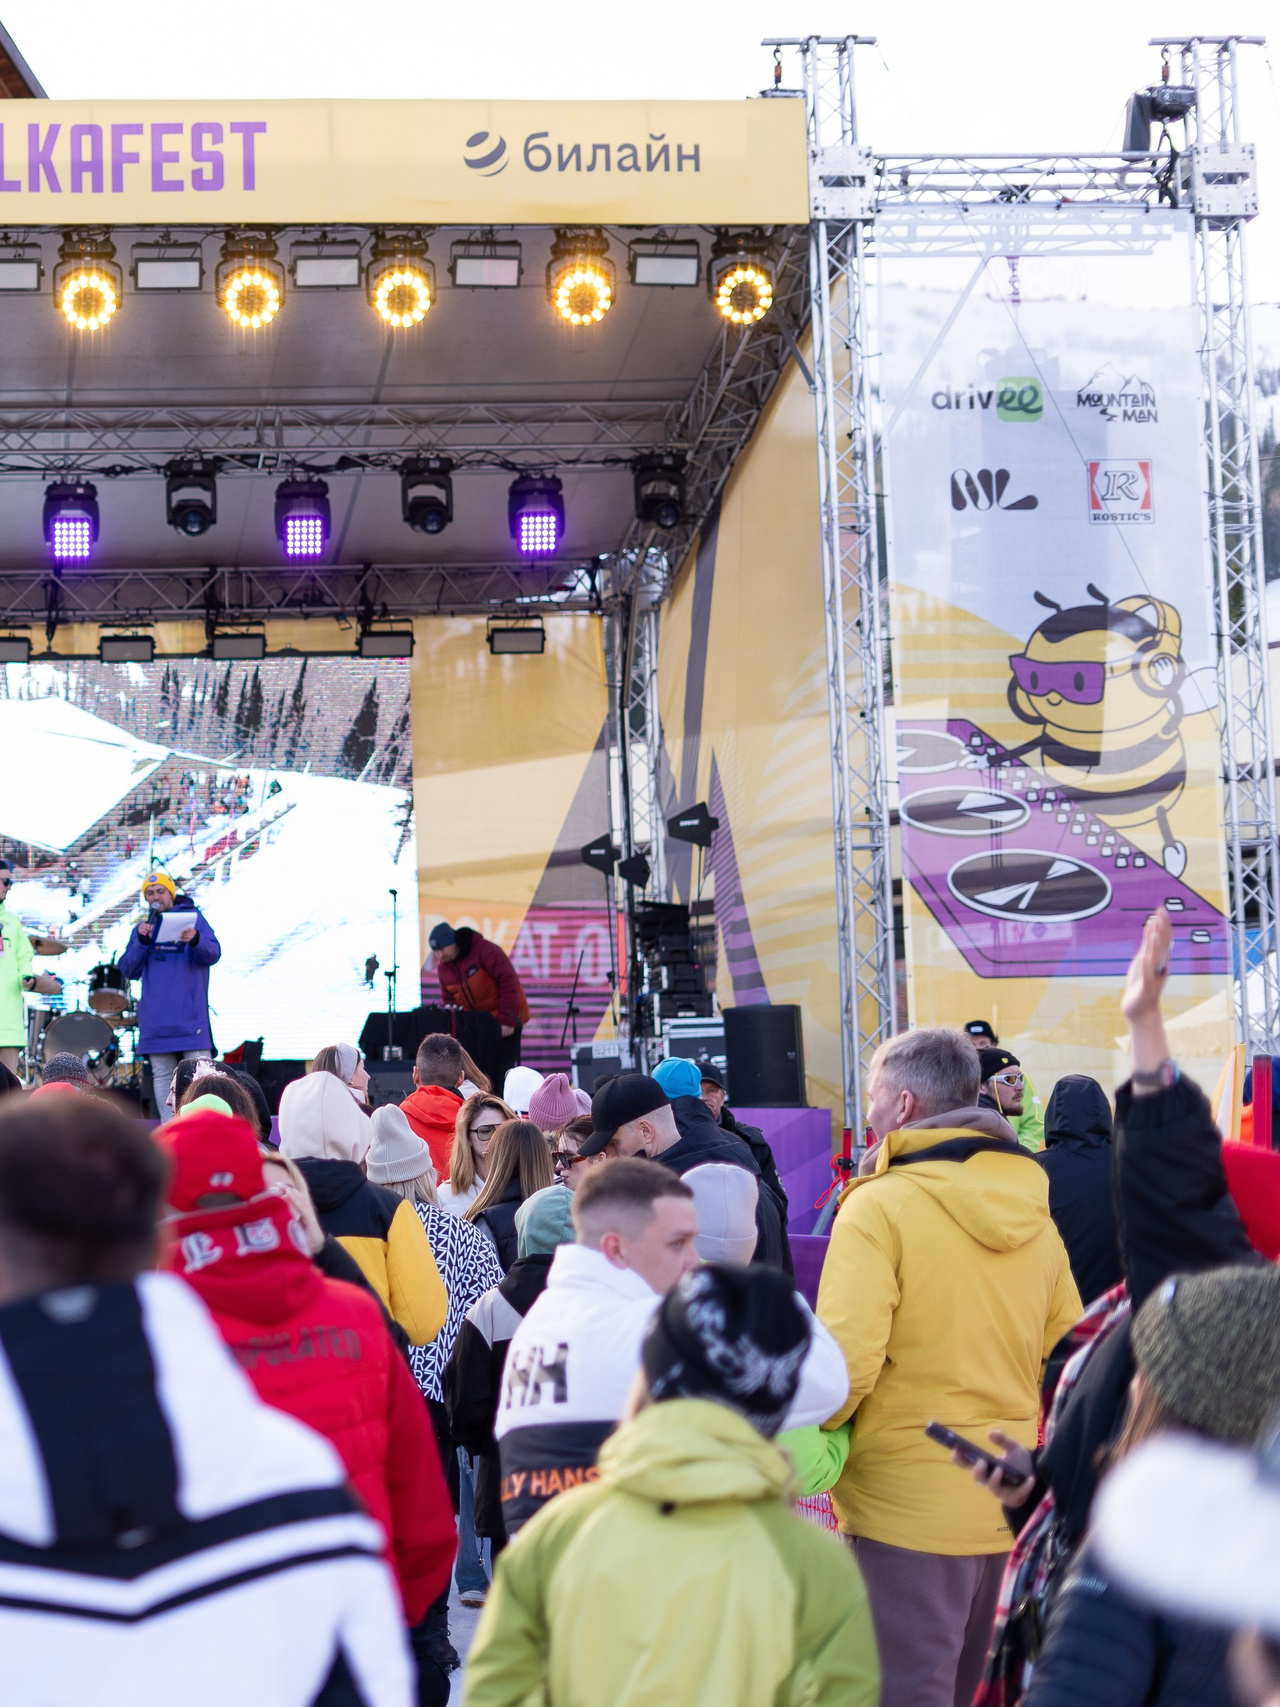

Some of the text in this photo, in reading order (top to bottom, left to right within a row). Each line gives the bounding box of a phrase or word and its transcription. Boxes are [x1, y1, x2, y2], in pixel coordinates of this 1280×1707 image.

[523, 131, 701, 173] билайн
[931, 383, 1044, 414] drivee
[1076, 392, 1157, 408] MOUNTAIN
[1122, 409, 1158, 423] MAN
[1092, 512, 1152, 521] ROSTIC'S
[506, 1342, 569, 1410] HH
